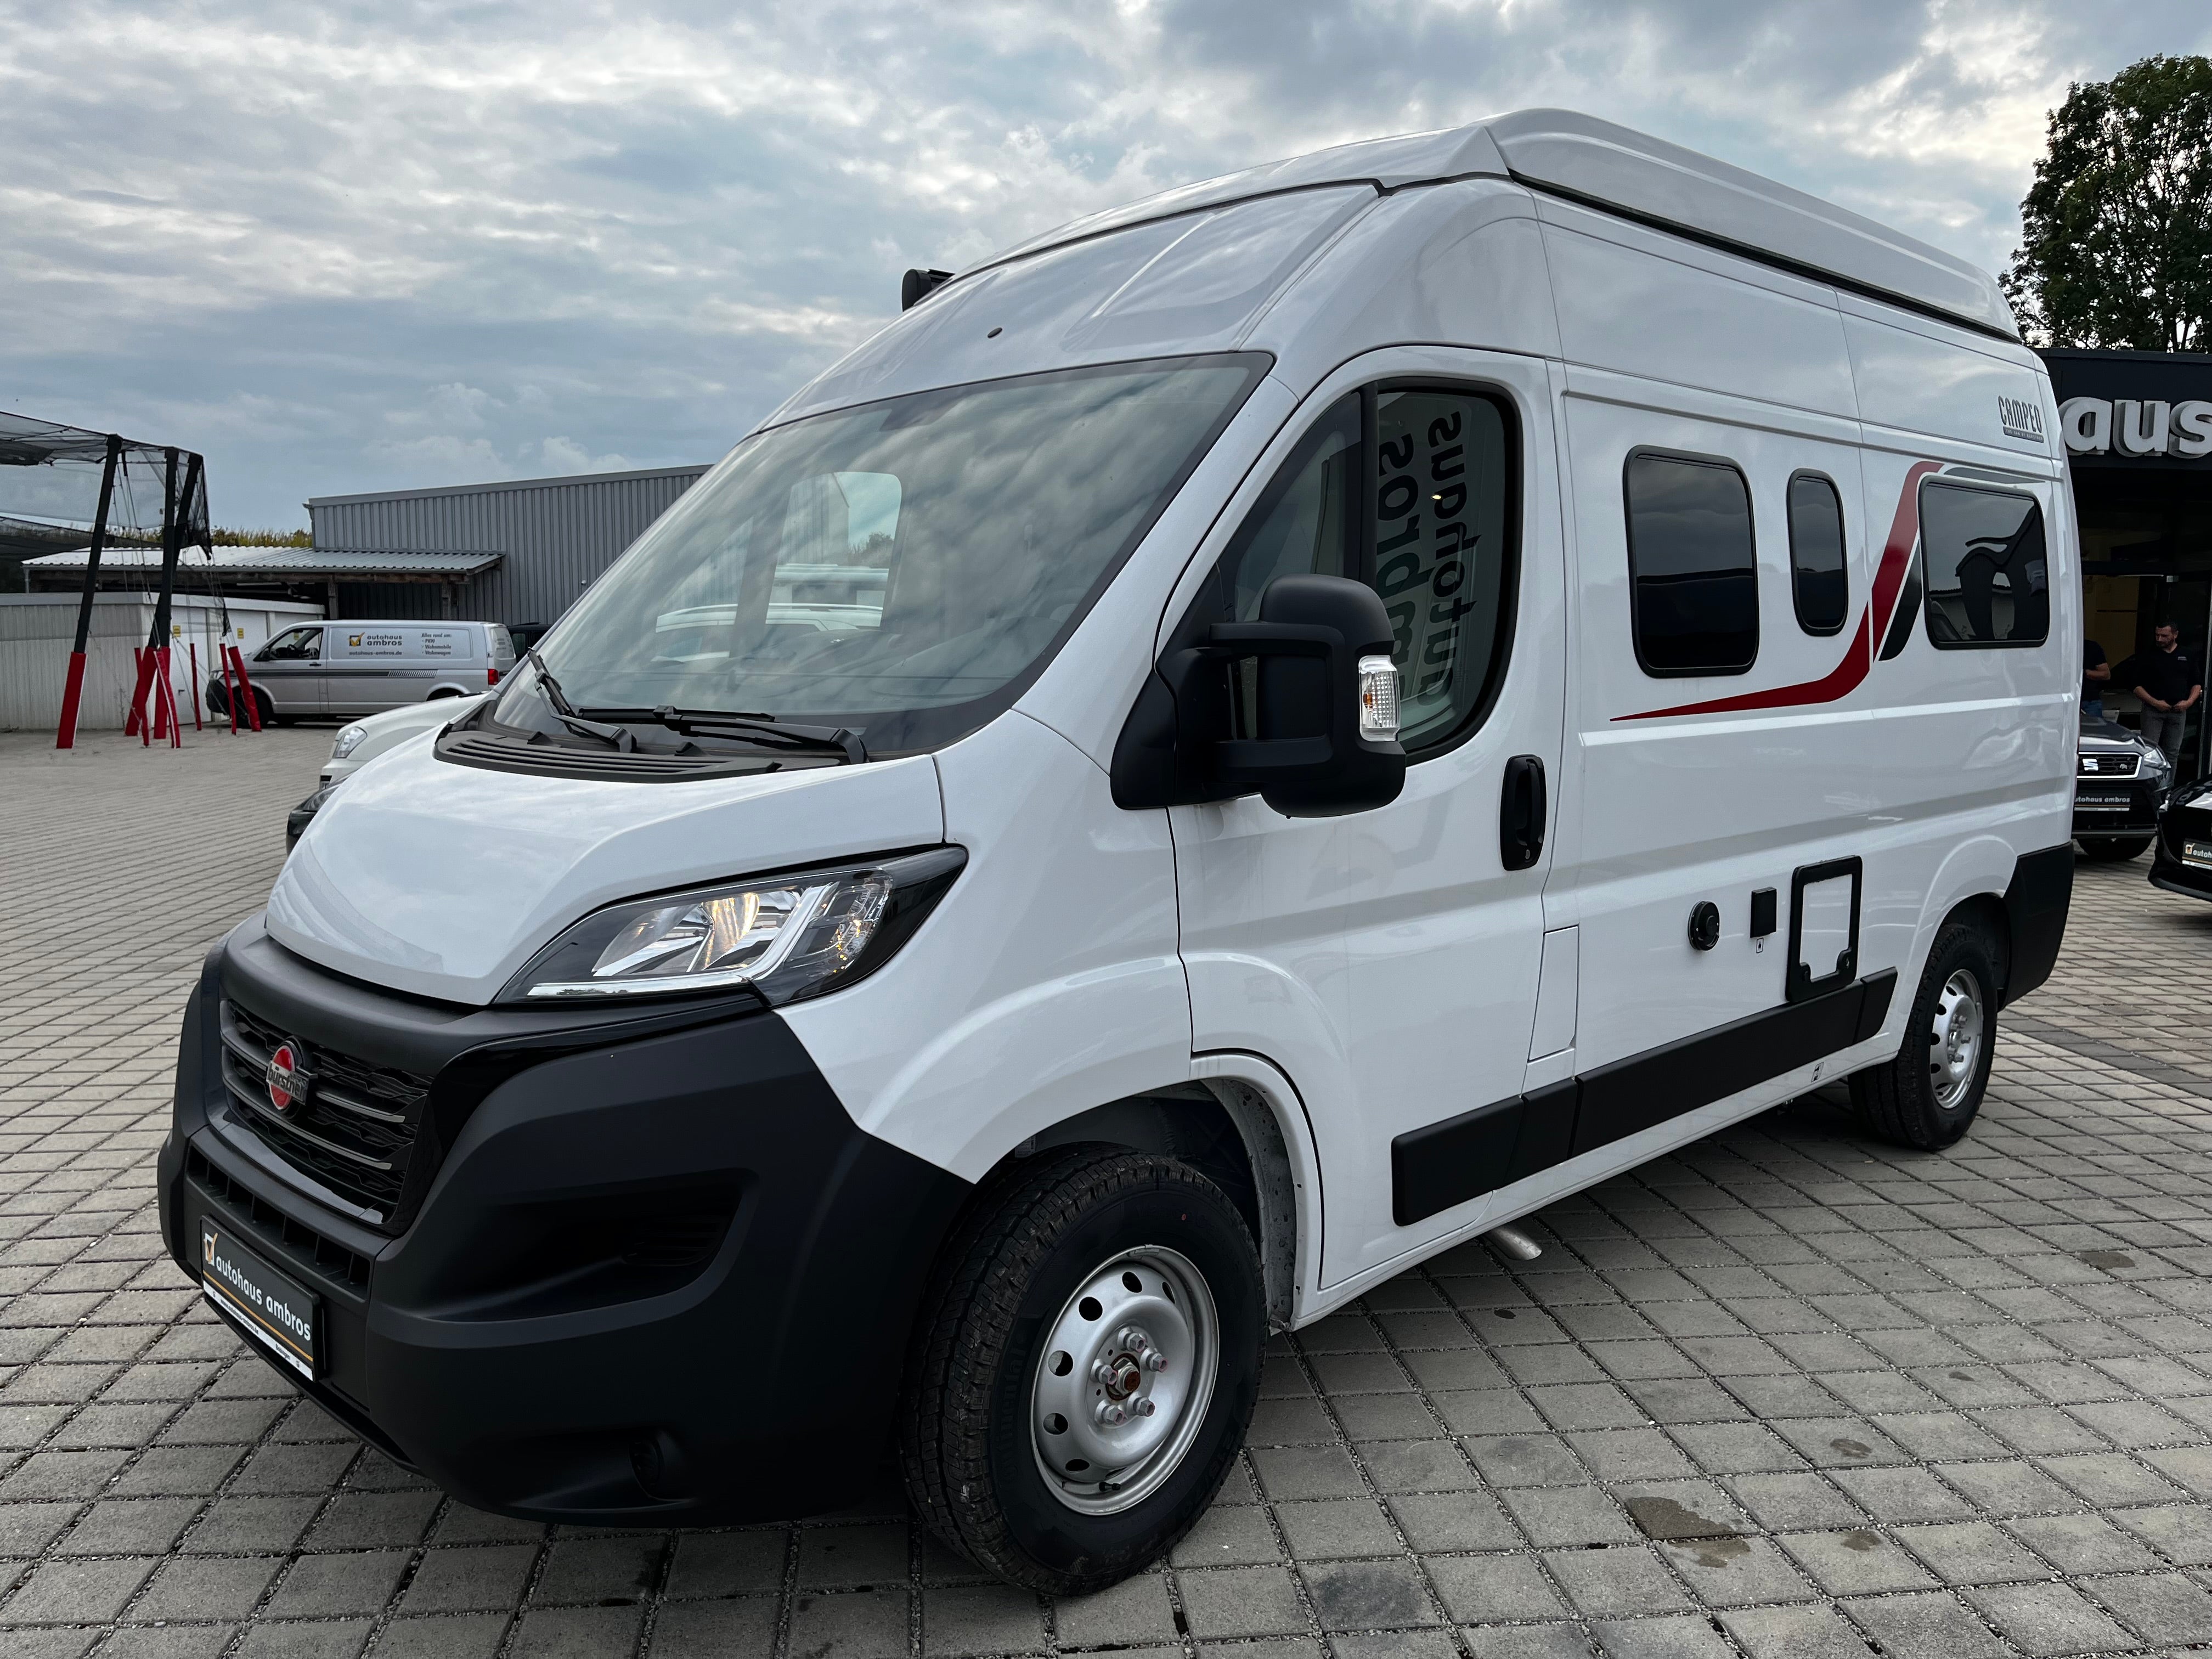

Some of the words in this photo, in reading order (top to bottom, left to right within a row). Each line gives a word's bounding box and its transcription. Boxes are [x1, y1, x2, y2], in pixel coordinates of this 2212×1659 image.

[1998, 395, 2042, 433] CAMPEO
[216, 1255, 263, 1306] autohaus
[266, 1296, 311, 1341] ambros
